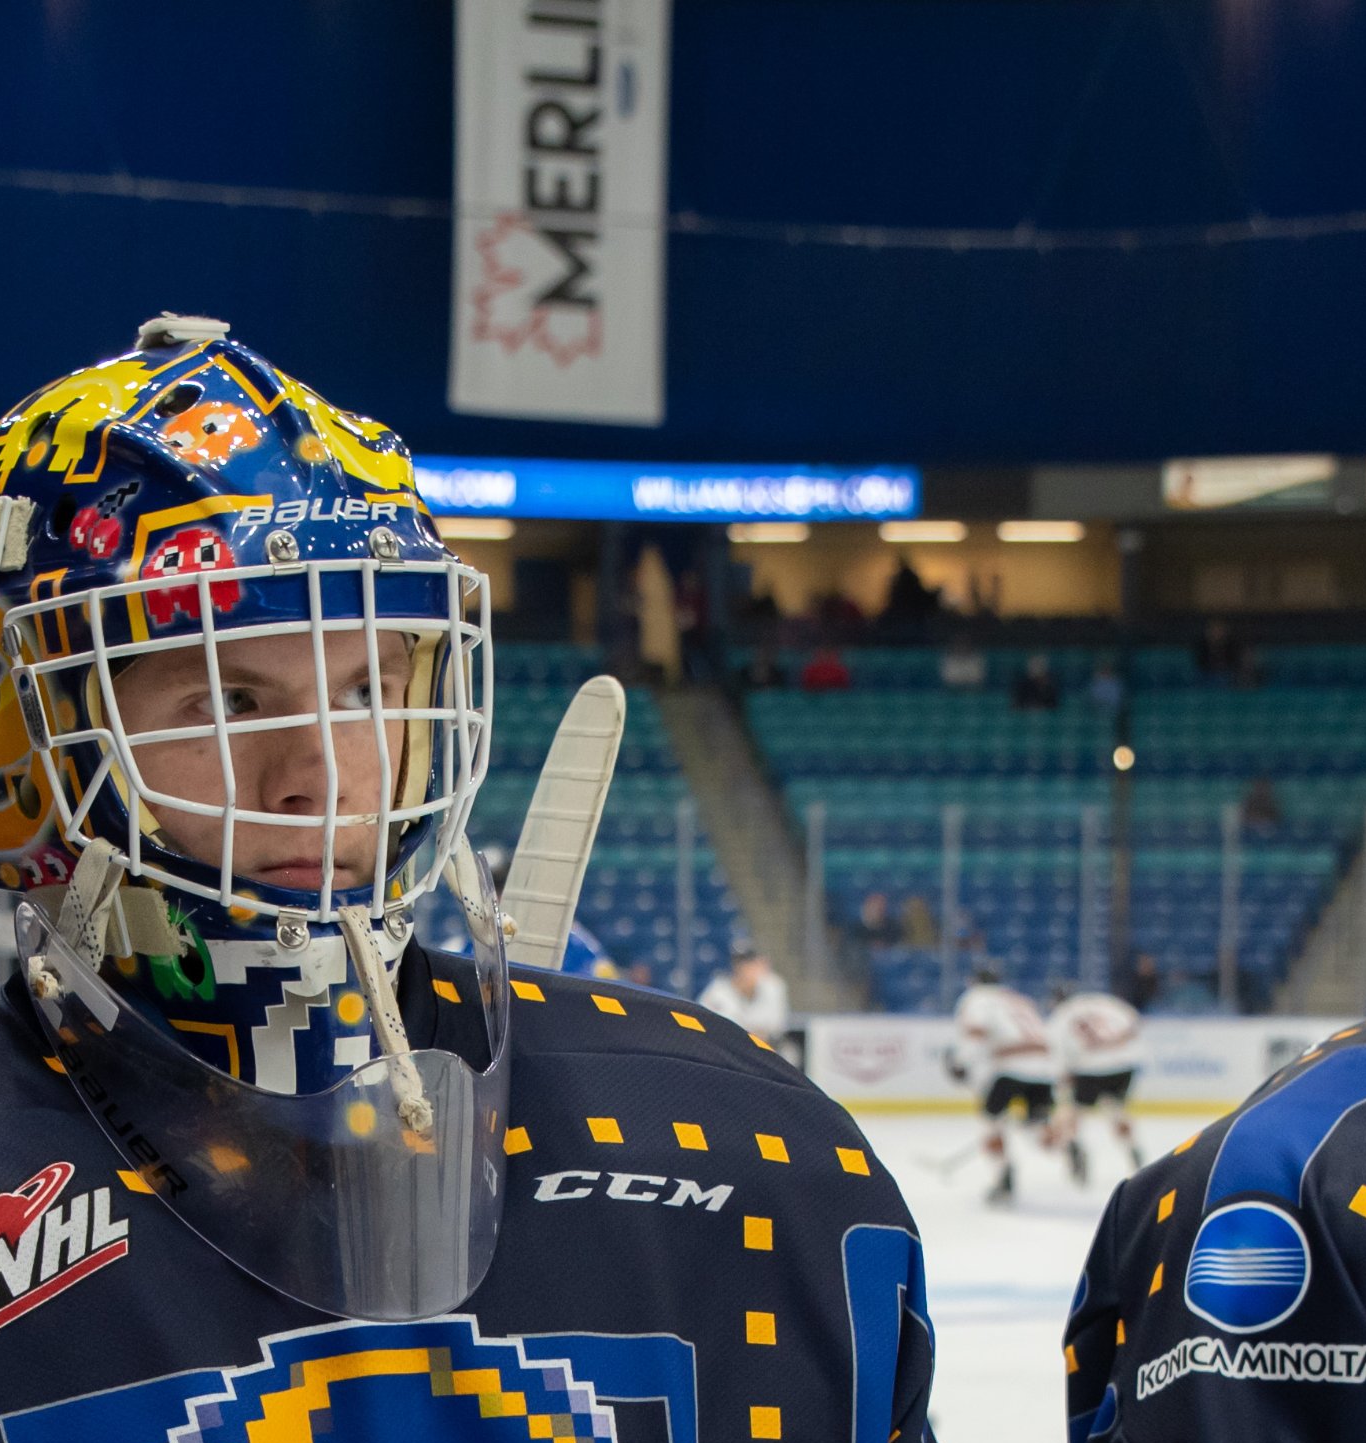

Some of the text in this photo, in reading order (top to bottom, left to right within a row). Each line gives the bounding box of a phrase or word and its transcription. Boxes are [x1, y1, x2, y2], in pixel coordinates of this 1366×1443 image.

[523, 0, 603, 308] MERLI
[534, 1170, 734, 1212] CCM
[1138, 1339, 1232, 1397] KONICA
